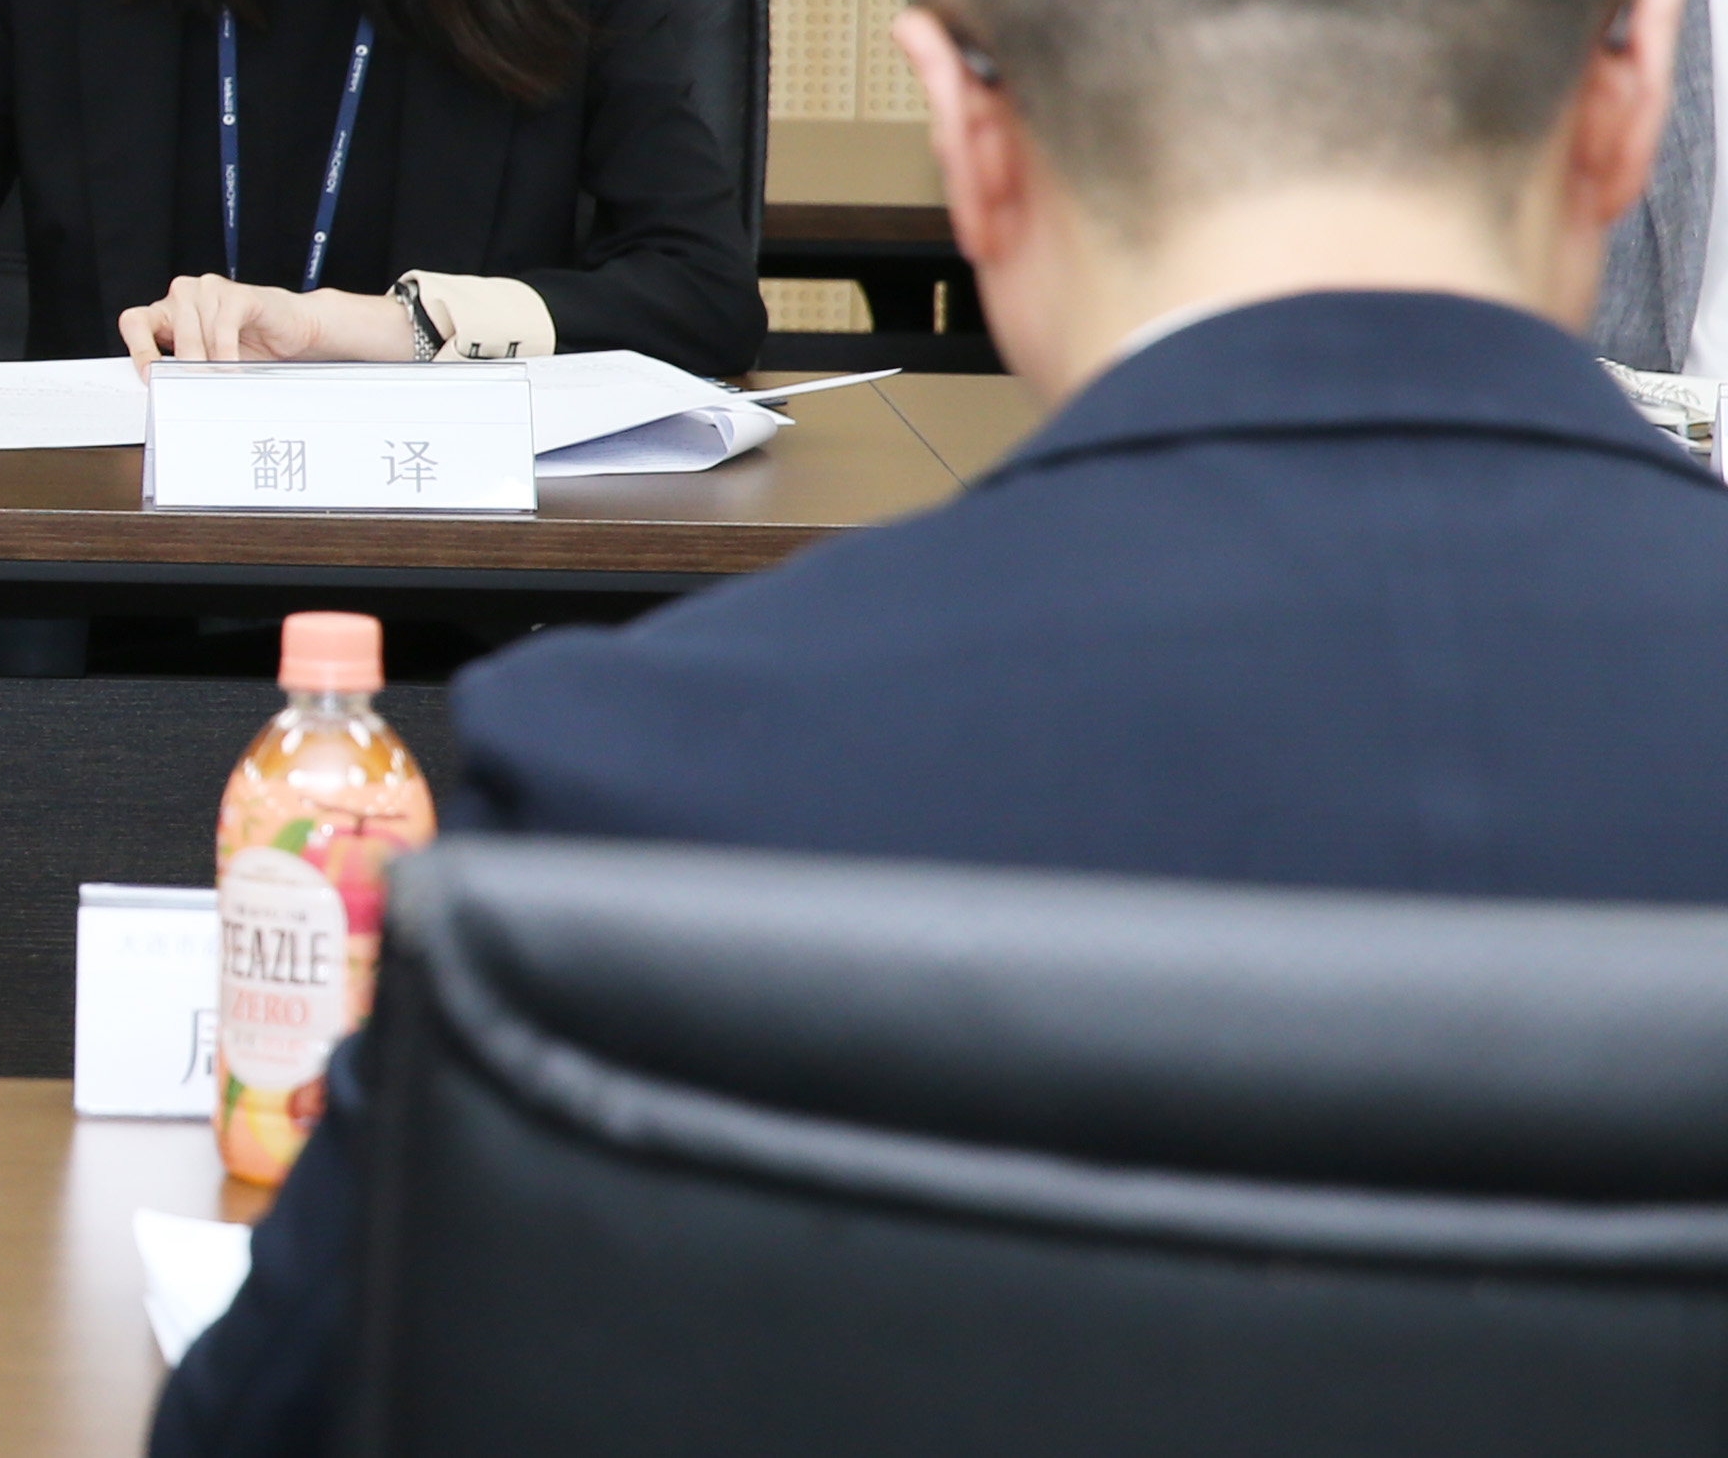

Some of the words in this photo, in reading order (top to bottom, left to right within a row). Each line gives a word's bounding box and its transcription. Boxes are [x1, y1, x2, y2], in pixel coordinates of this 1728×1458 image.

[250, 437, 439, 493] 翻译
[221, 918, 329, 986] TEAZLE
[232, 986, 309, 1027] ZERO
